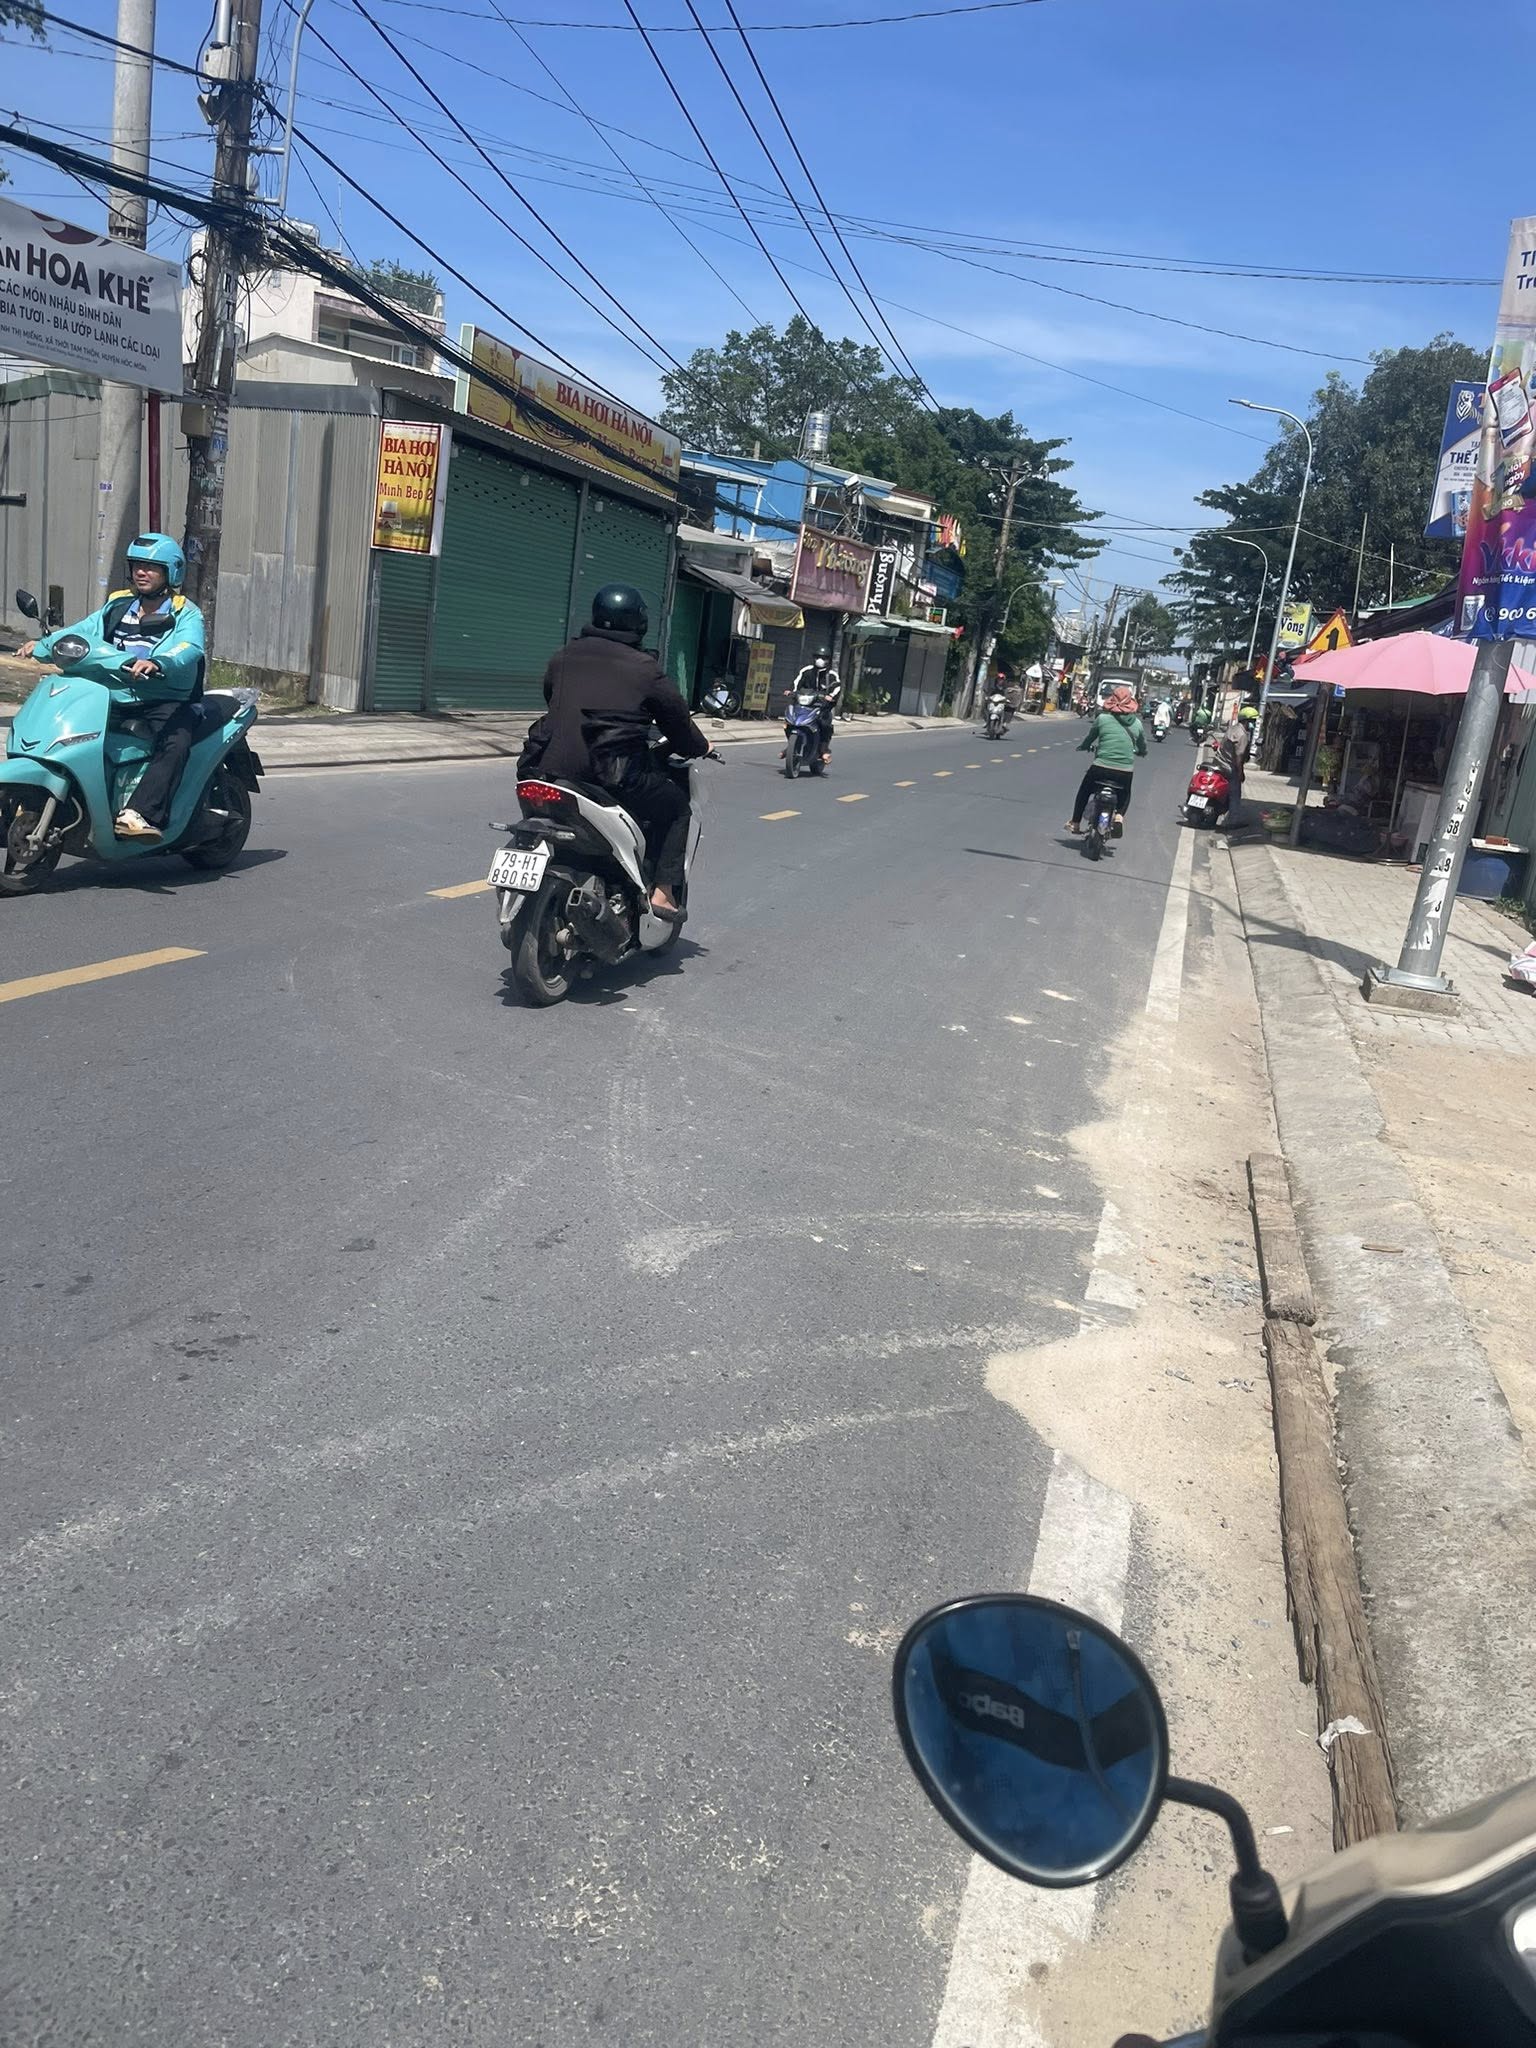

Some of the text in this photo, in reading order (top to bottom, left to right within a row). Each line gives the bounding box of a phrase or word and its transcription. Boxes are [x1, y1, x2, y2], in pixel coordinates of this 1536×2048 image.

[27, 243, 91, 296] HOA
[98, 268, 154, 316] KHẾ
[22, 286, 47, 306] MÓN
[49, 294, 77, 316] NHẬU
[78, 303, 101, 323] BÌNH
[102, 310, 122, 329] DÂN
[0, 300, 17, 317] BIA
[19, 305, 46, 325] TƯƠI
[53, 316, 69, 333] BIA
[71, 320, 92, 338] ƯỚP
[94, 330, 119, 348] LẠNH
[120, 335, 139, 353] CÁC
[140, 343, 161, 362] LOẠI
[556, 381, 582, 413] BIA
[583, 395, 610, 426] HƠI
[610, 409, 630, 437] HÀ
[631, 419, 653, 448] NỘI
[384, 437, 407, 455] BIA
[384, 456, 433, 482] HÀ NỘI
[379, 482, 402, 497] Minh
[426, 487, 434, 501] 2
[867, 551, 895, 615] Phượng
[501, 851, 538, 872] 79-H1
[491, 868, 539, 890] 890.65
